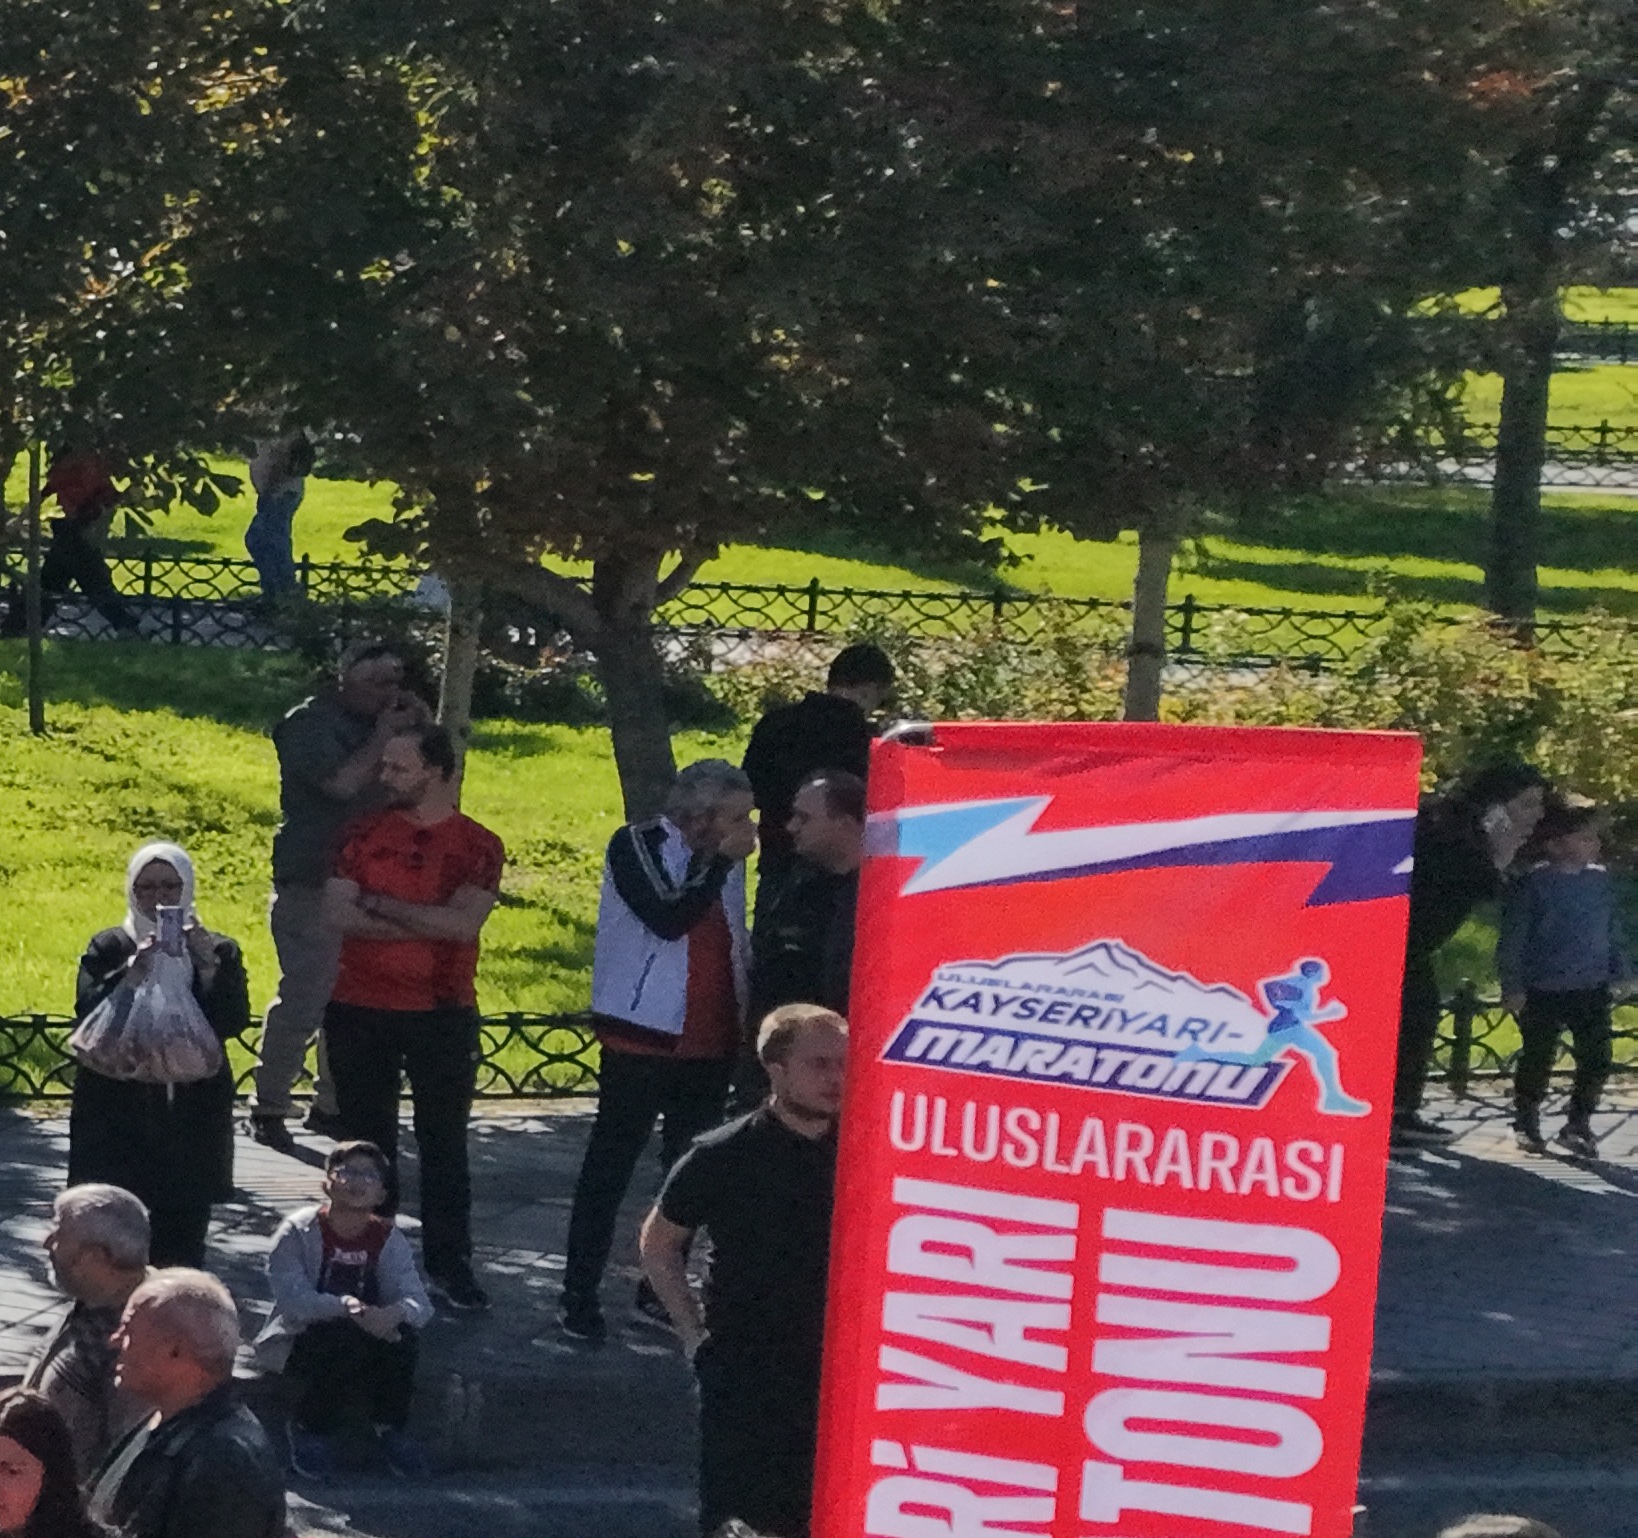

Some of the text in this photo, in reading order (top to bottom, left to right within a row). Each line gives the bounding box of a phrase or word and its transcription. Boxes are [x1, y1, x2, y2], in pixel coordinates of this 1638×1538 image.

[903, 1023, 1273, 1104] MARATONU
[889, 1090, 1346, 1204] ULUSLARARASI
[875, 1176, 1082, 1418] YARI
